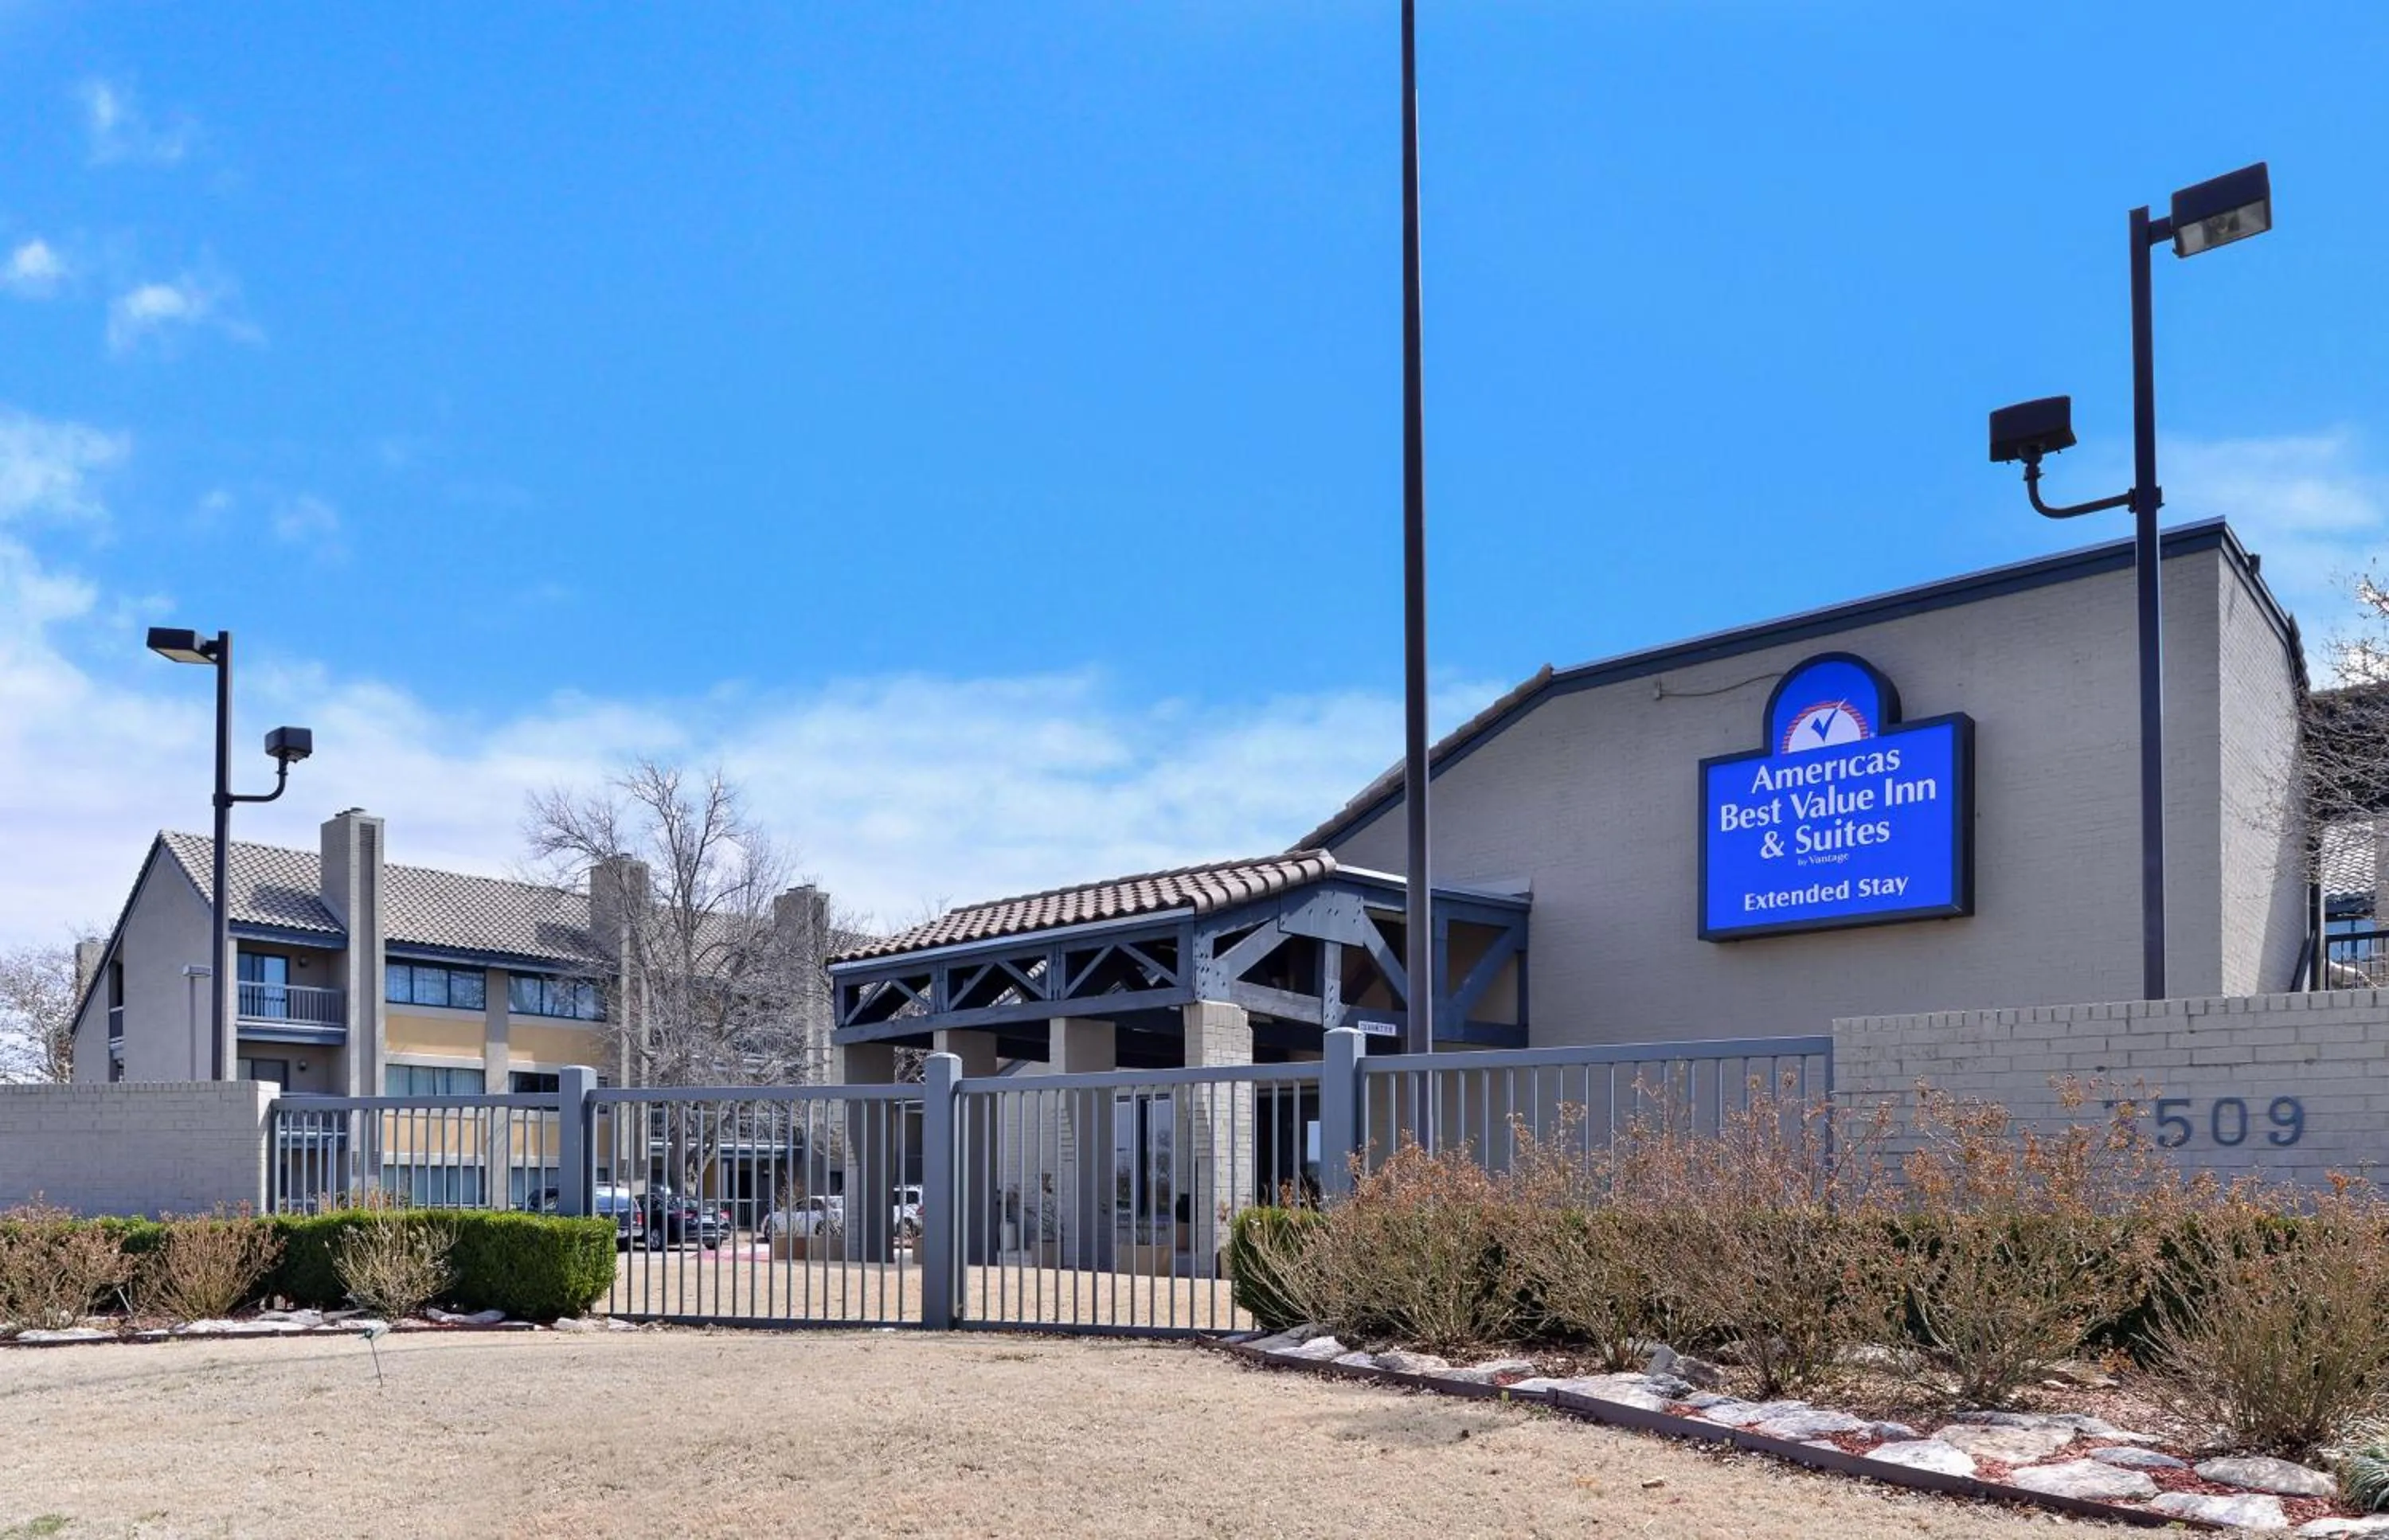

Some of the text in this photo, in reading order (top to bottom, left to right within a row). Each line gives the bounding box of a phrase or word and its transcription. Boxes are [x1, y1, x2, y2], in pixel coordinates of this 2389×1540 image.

[1752, 749, 1901, 794] Americas
[1721, 778, 1936, 832] Best Value Inn
[1760, 819, 1890, 859] & Suites
[1808, 854, 1849, 864] Vantage
[1744, 877, 1909, 912] Extended Stay
